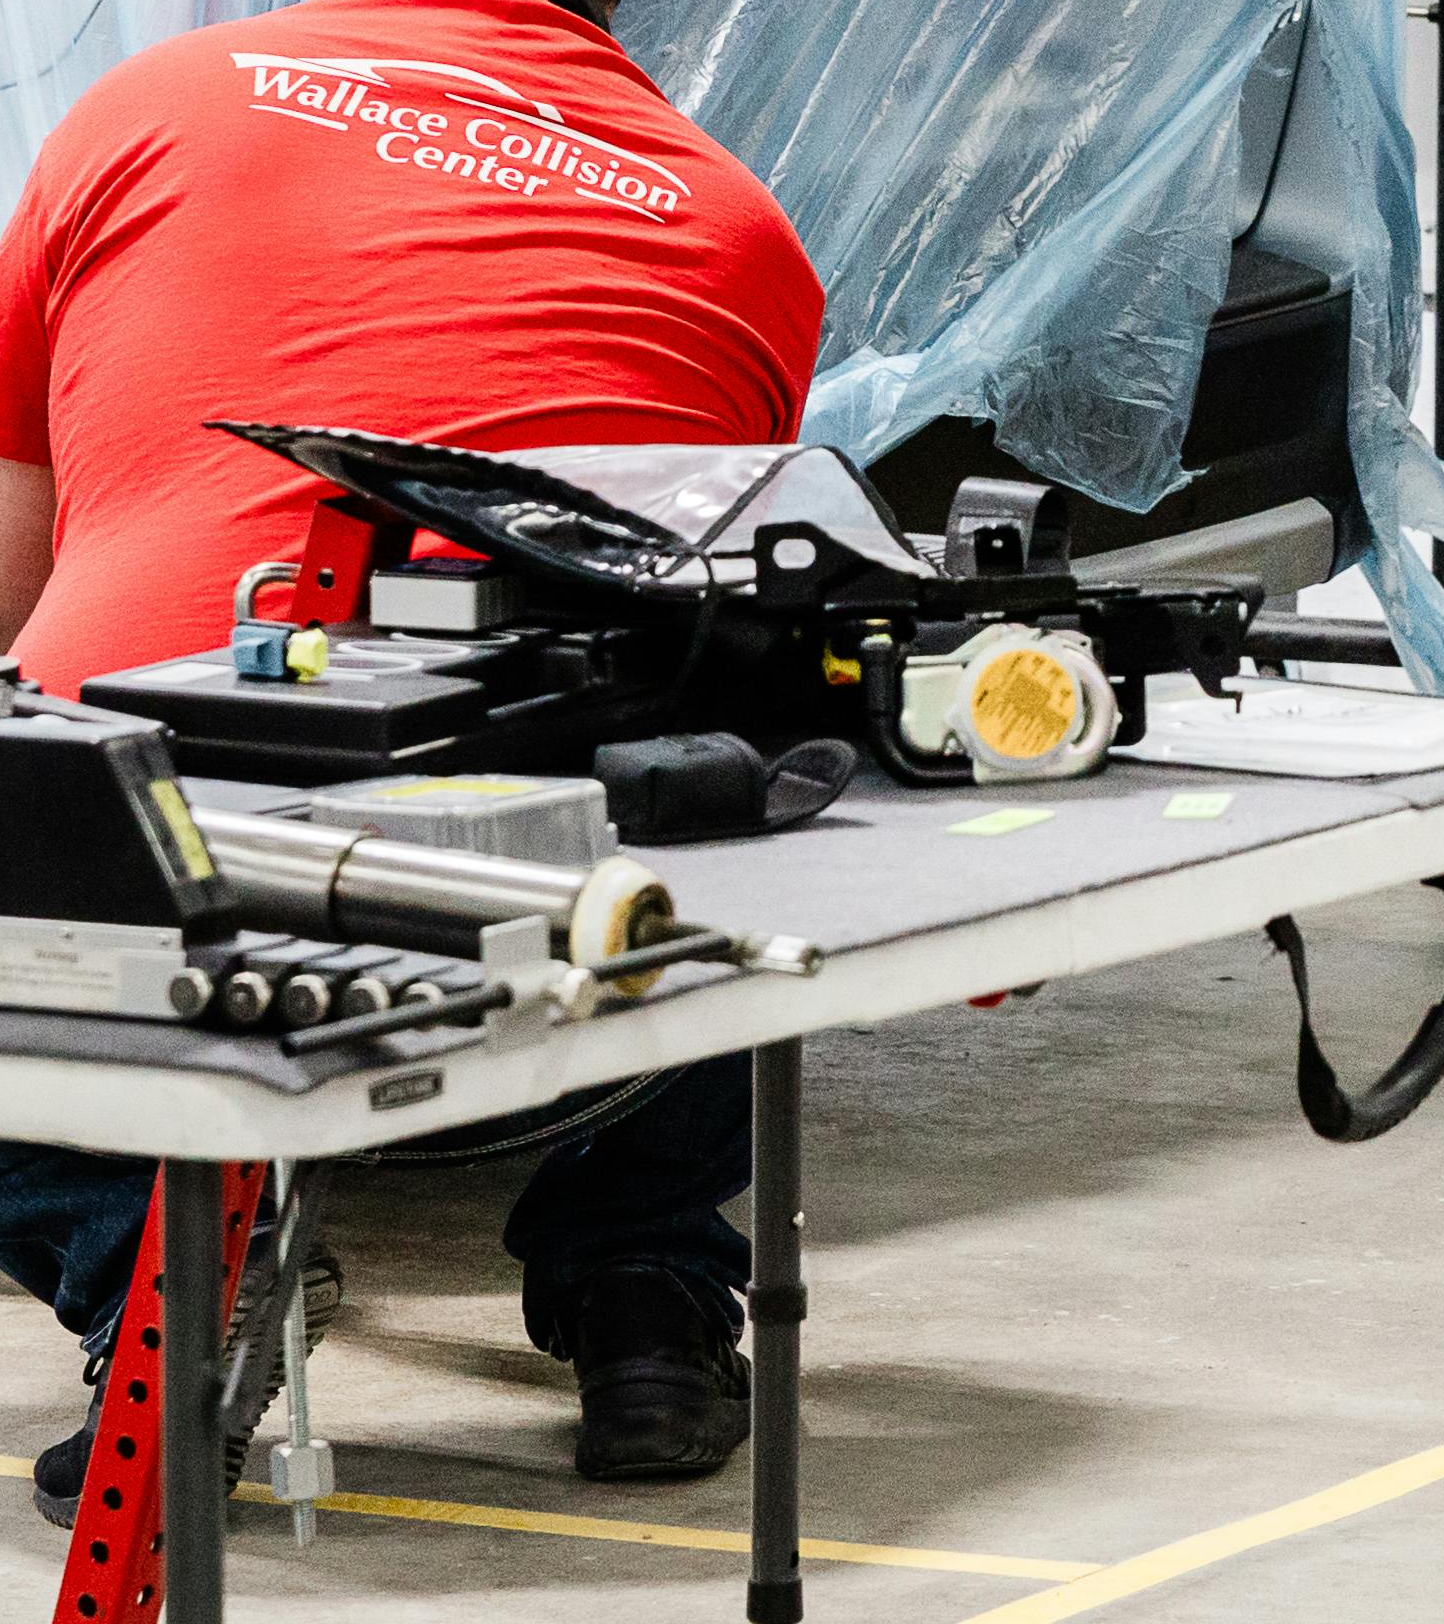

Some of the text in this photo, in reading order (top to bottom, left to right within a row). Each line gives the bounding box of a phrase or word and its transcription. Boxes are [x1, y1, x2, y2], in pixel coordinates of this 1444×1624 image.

[252, 66, 679, 213] Wallace Collision
[375, 132, 548, 197] Center
